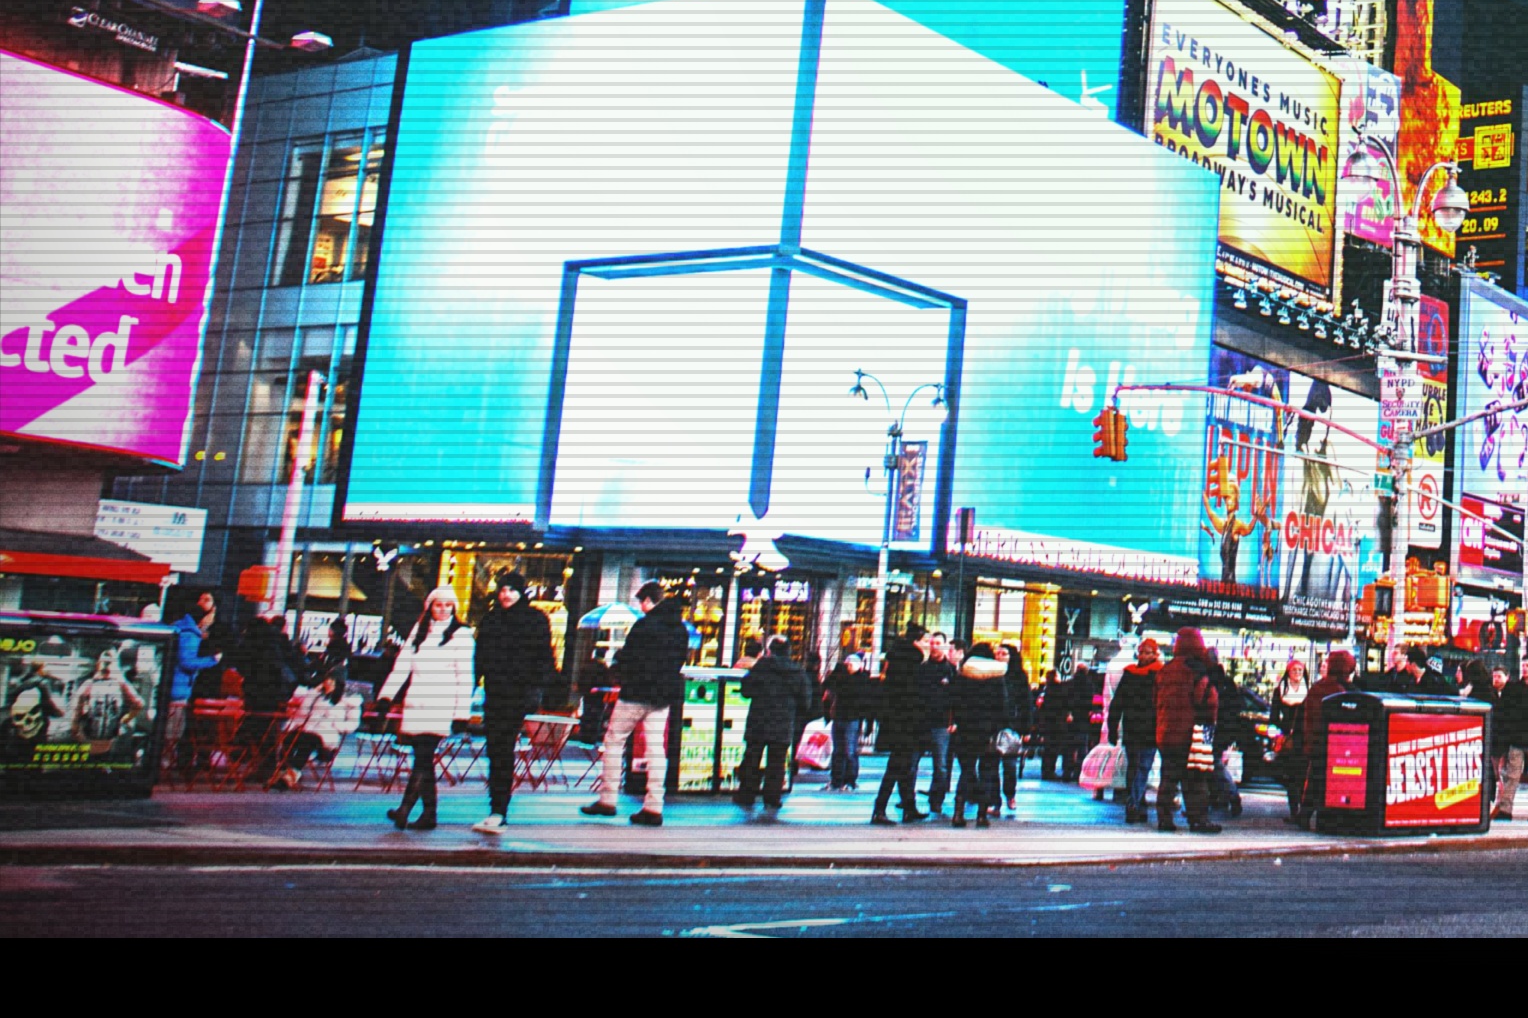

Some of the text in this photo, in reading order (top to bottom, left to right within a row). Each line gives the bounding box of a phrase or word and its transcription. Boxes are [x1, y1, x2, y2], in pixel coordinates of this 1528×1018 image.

[1161, 22, 1271, 103] EVERYONE'S
[1456, 99, 1512, 119] REUTERS
[1153, 55, 1329, 207] MOTOWN
[1461, 217, 1499, 234] 20.09
[1387, 379, 1416, 388] NYPD
[1386, 746, 1444, 806] JERSEY
